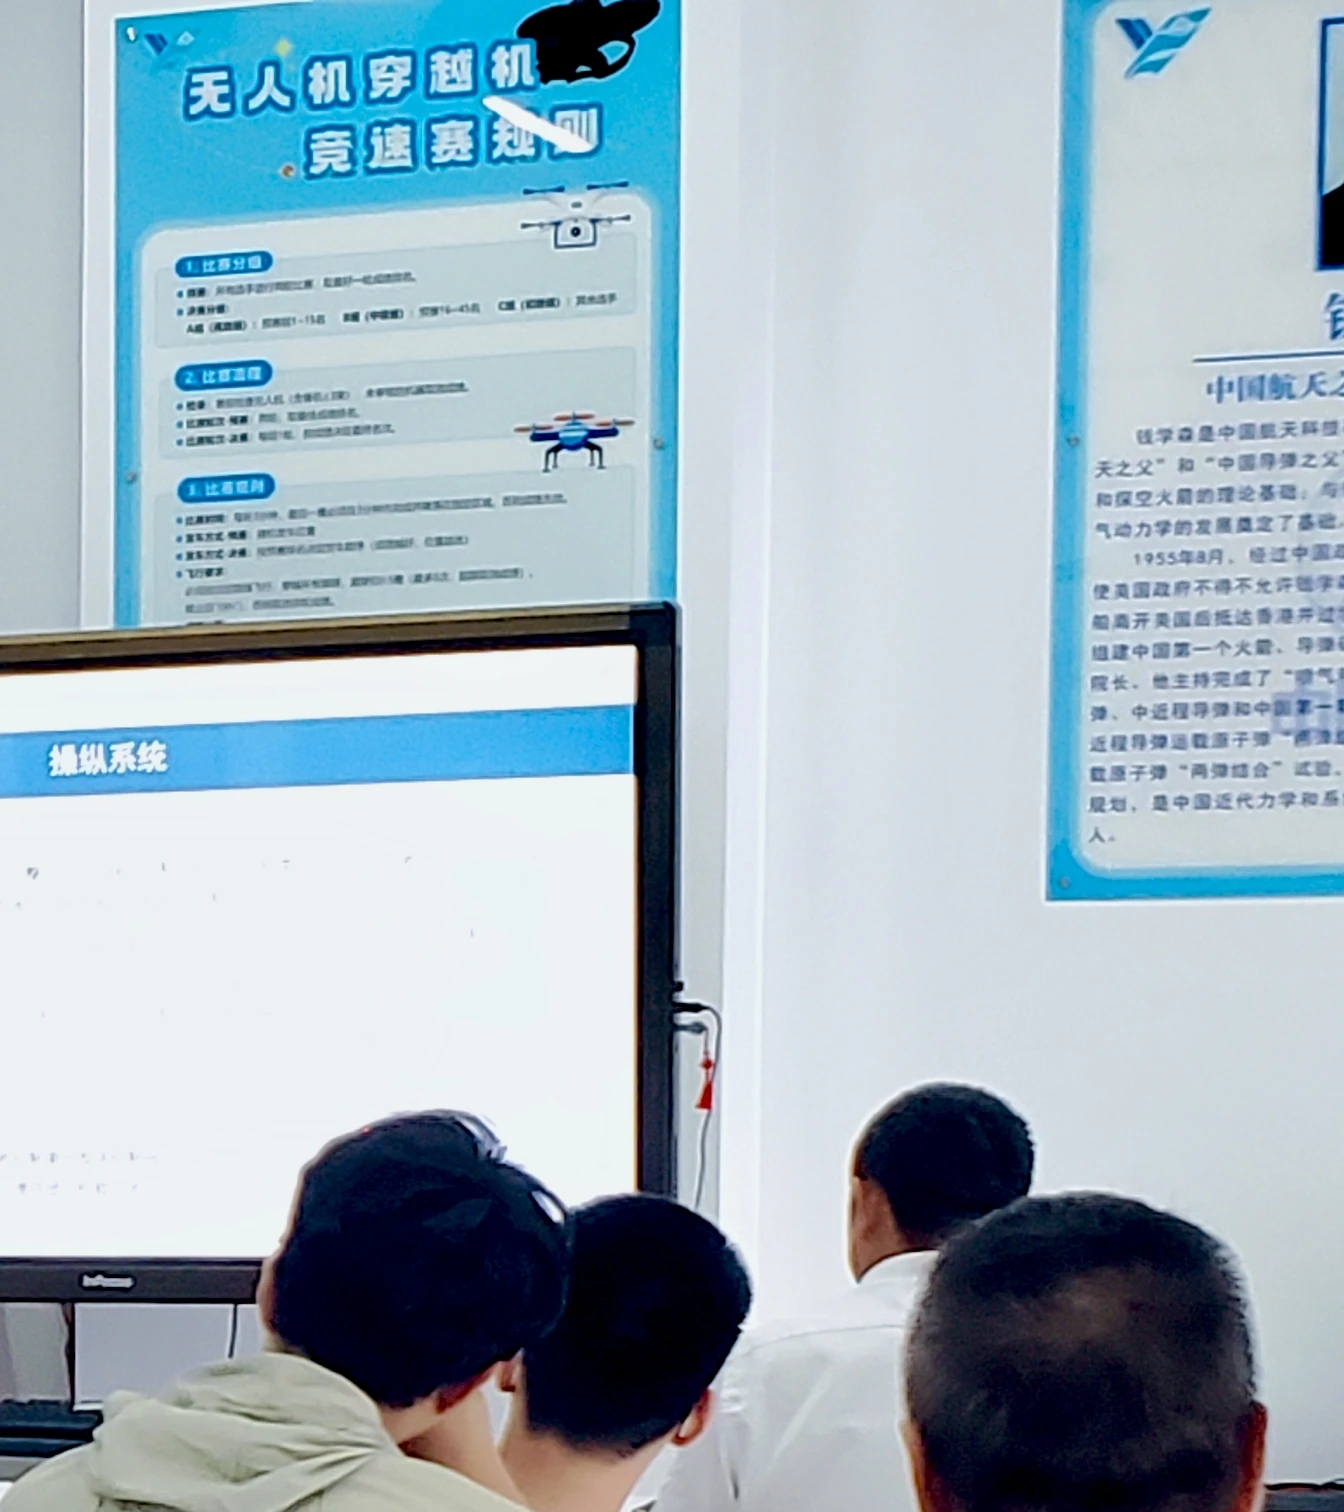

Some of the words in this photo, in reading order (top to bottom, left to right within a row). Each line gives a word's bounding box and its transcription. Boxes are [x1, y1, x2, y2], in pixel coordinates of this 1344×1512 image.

[187, 38, 537, 117] 无人机穿越机
[1136, 420, 1344, 446] 钱学森是中国航天科技
[48, 739, 169, 777] 操纵系统
